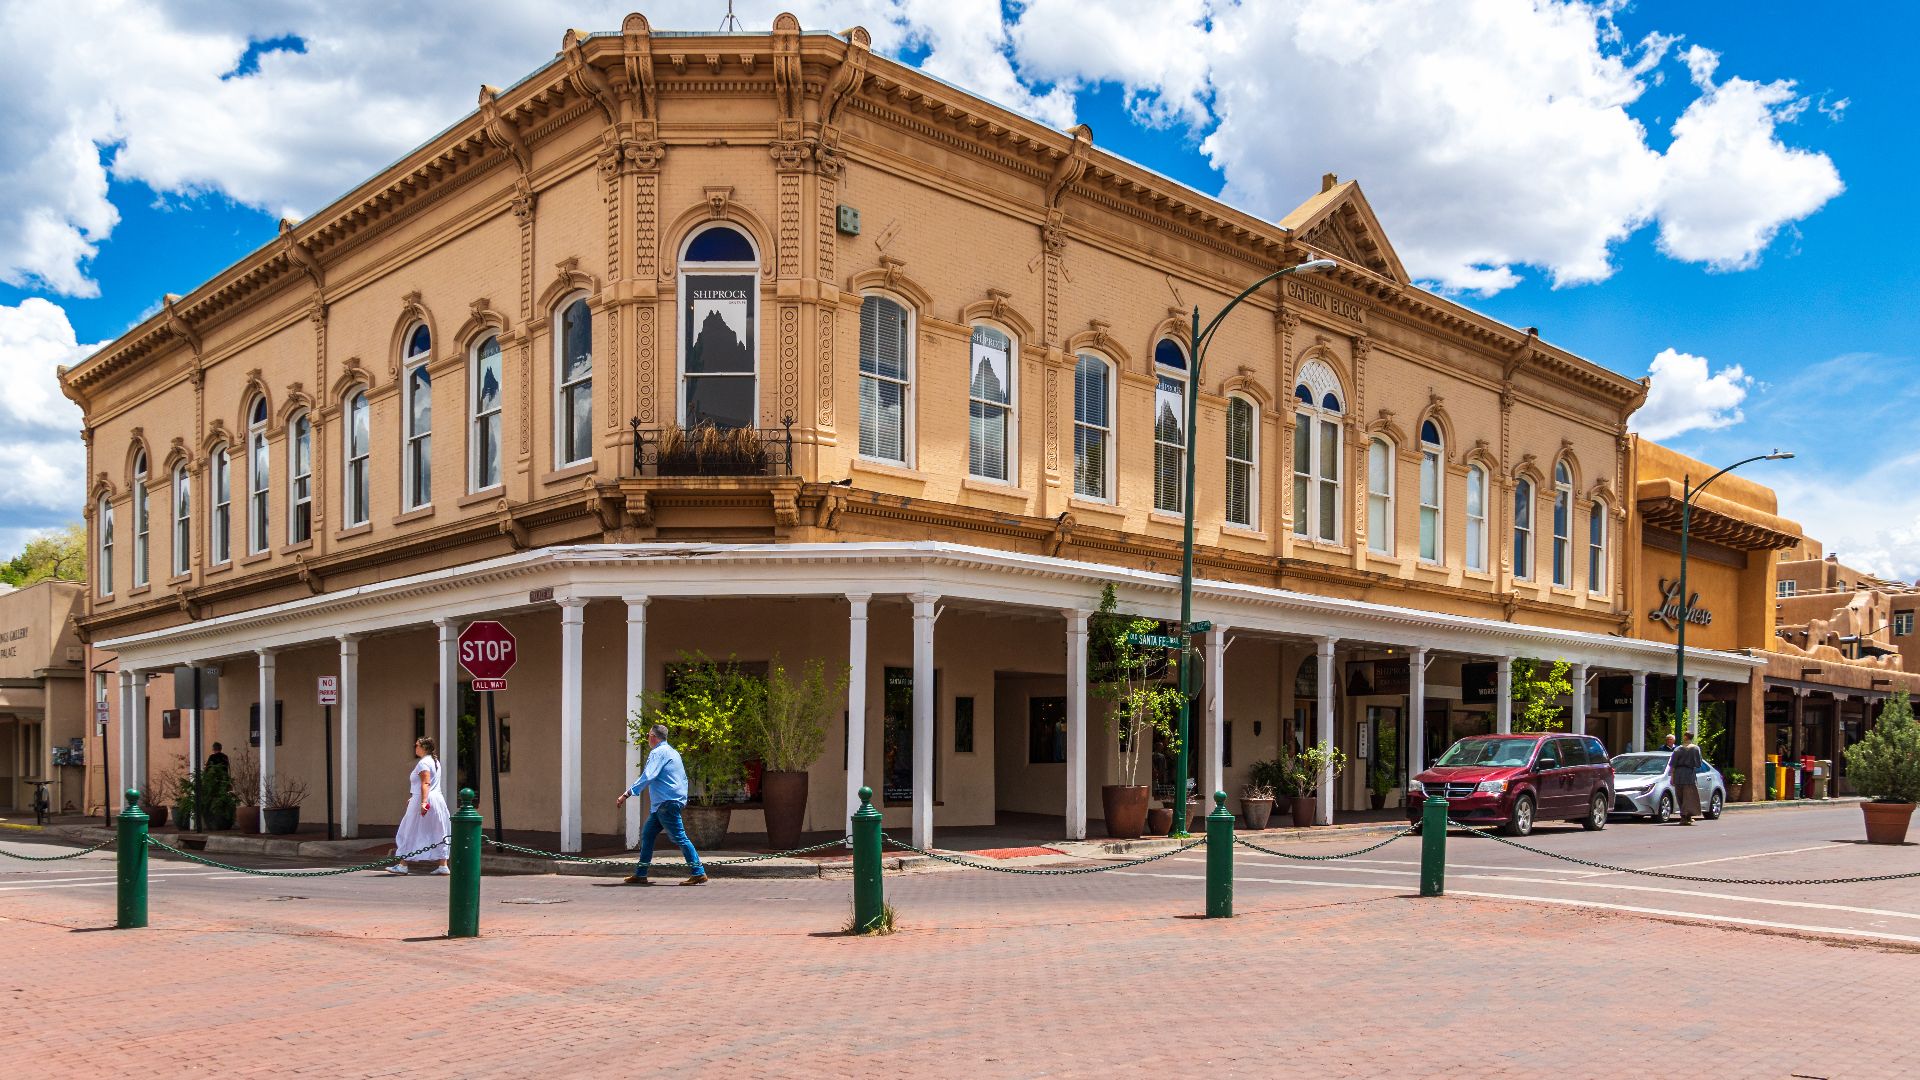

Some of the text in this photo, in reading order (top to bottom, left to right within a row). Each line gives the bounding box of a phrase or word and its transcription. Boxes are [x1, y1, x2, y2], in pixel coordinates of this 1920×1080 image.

[693, 290, 748, 299] SHIPROCK
[1287, 280, 1363, 324] CATRON BLOCK
[1138, 635, 1157, 646] SANTA
[1158, 637, 1167, 647] FE
[462, 640, 512, 662] STOP
[490, 681, 504, 689] WAY
